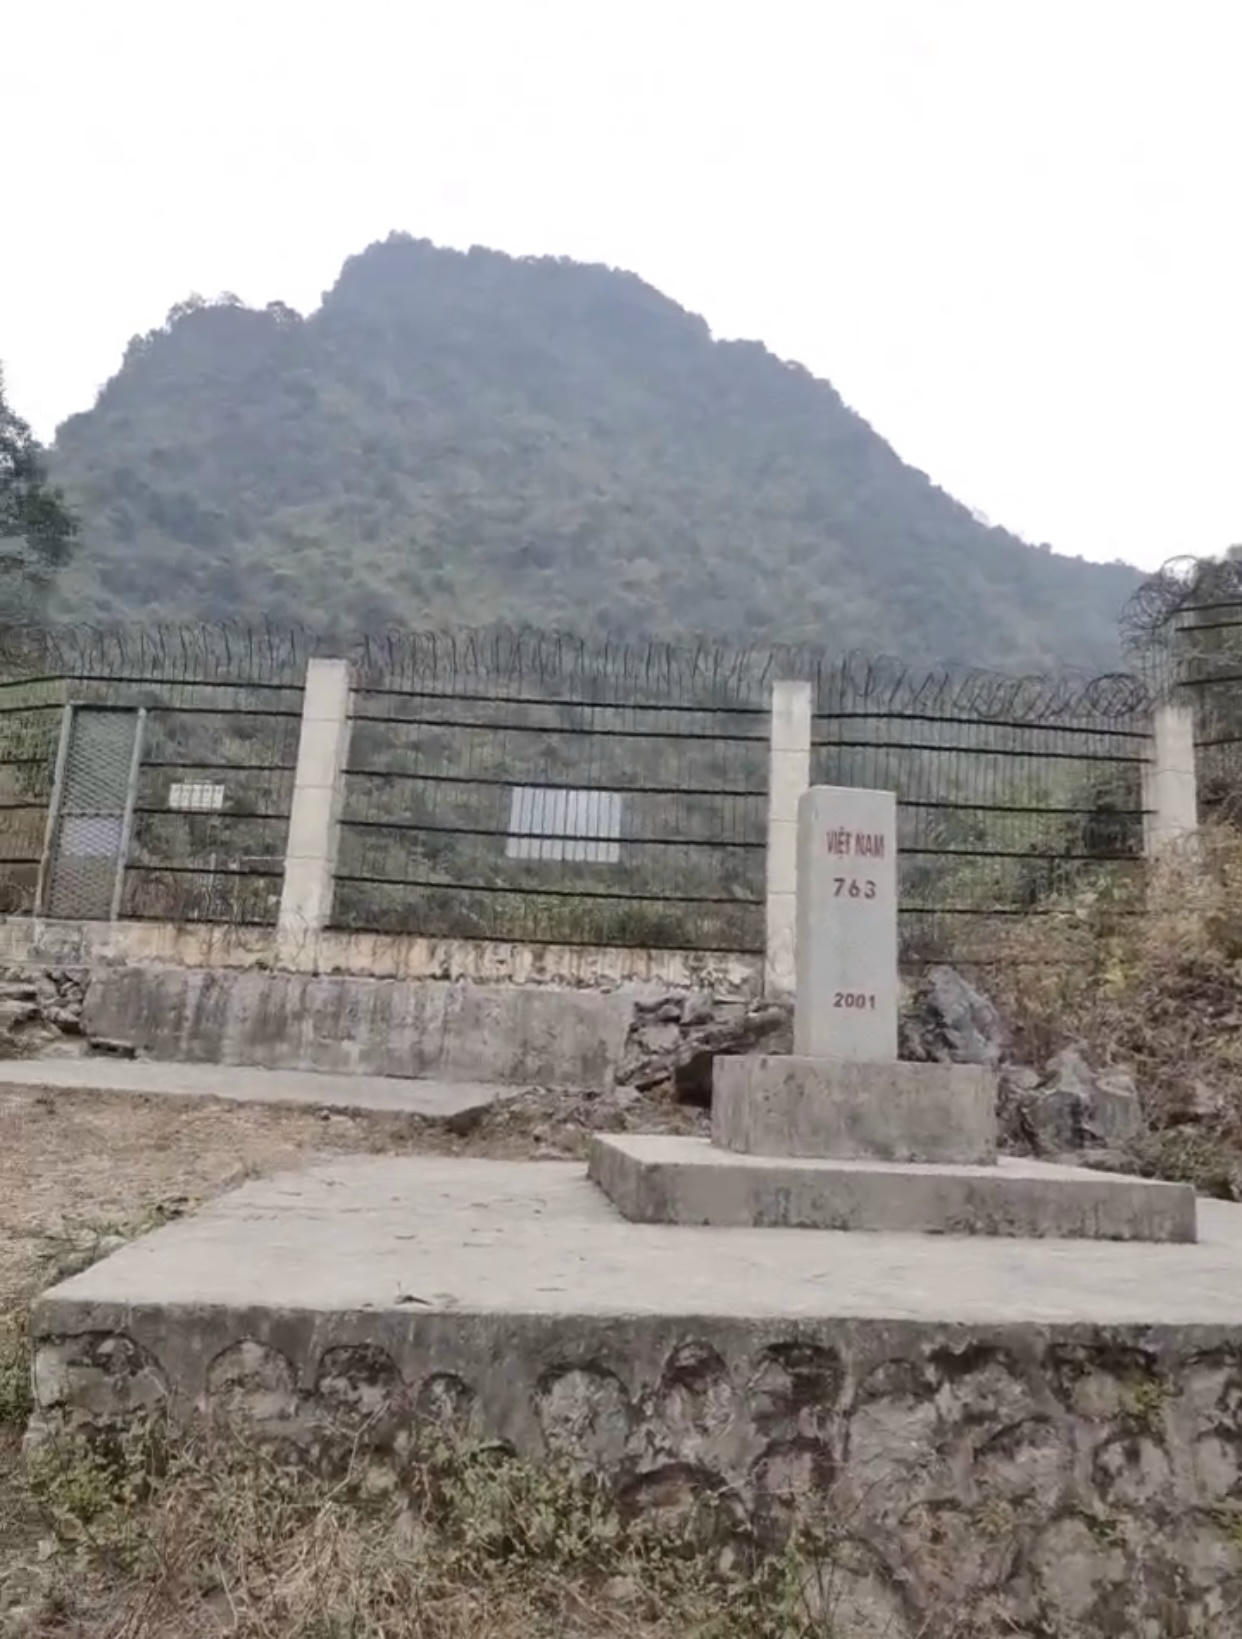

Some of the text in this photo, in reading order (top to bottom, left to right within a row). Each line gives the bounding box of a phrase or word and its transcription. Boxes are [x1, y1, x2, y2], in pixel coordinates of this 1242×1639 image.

[855, 833, 885, 859] NAM
[833, 877, 876, 899] 763
[833, 992, 876, 1010] 2001
